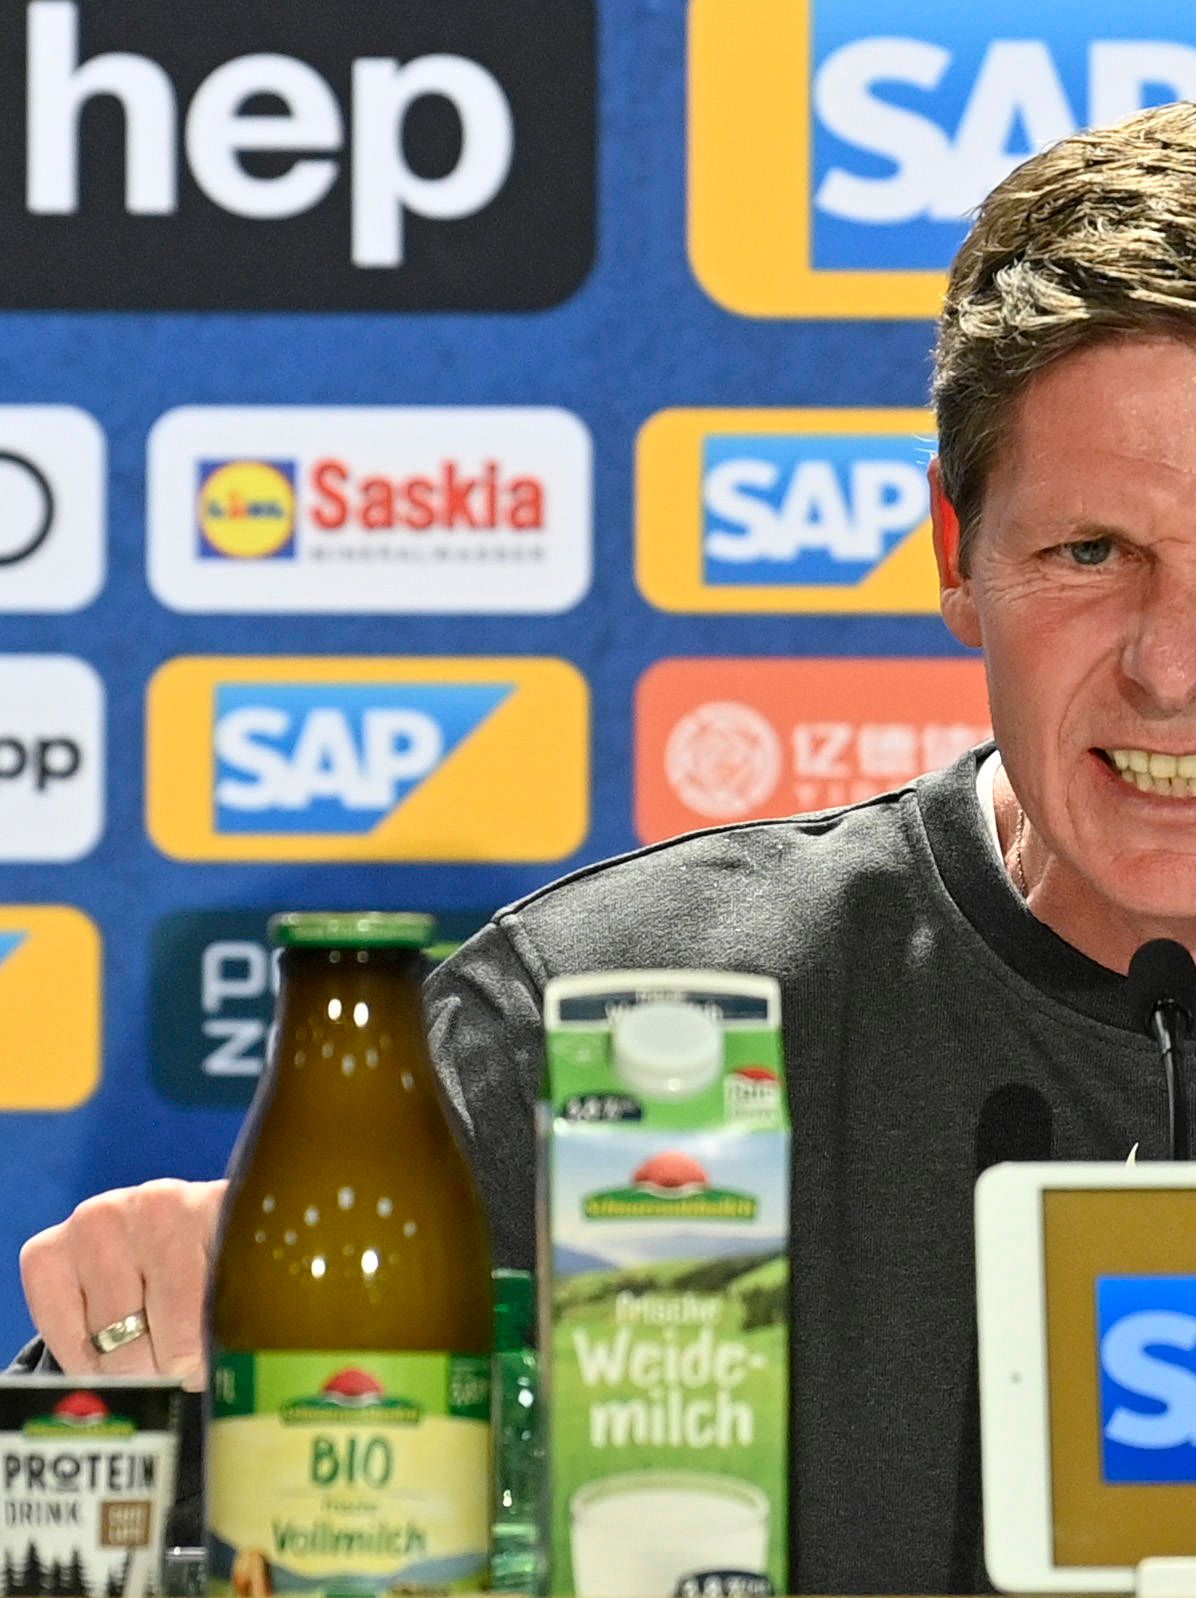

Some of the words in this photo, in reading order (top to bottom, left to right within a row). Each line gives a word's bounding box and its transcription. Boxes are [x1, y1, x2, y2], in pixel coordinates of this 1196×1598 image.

[26, 0, 514, 267] hep
[310, 459, 545, 532] Saskia
[705, 459, 930, 562] SAP
[215, 706, 443, 812] SAP
[570, 1325, 769, 1389] Weide-
[589, 1385, 754, 1449] milch
[3, 1452, 157, 1492] PROTEIN
[311, 1435, 393, 1488] BIO
[3, 1502, 81, 1528] DRINK
